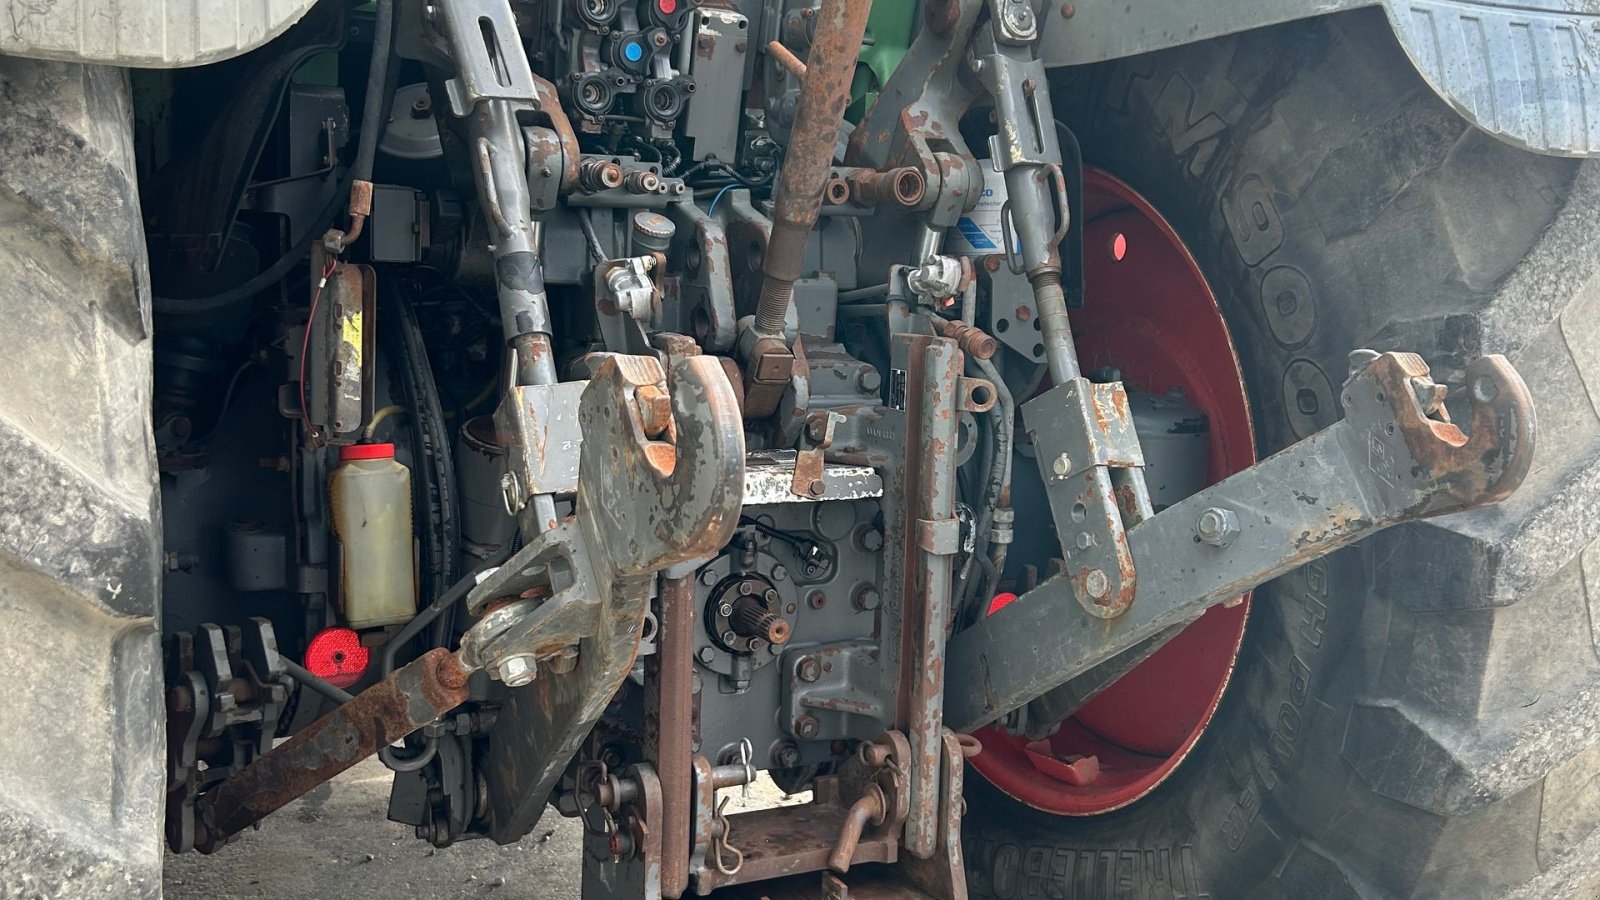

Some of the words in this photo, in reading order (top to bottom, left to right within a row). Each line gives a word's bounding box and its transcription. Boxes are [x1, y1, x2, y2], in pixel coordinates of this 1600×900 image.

[1300, 556, 1330, 650] GH
[1219, 653, 1312, 852] POWER
[967, 837, 1209, 900] TRELLEBOR
